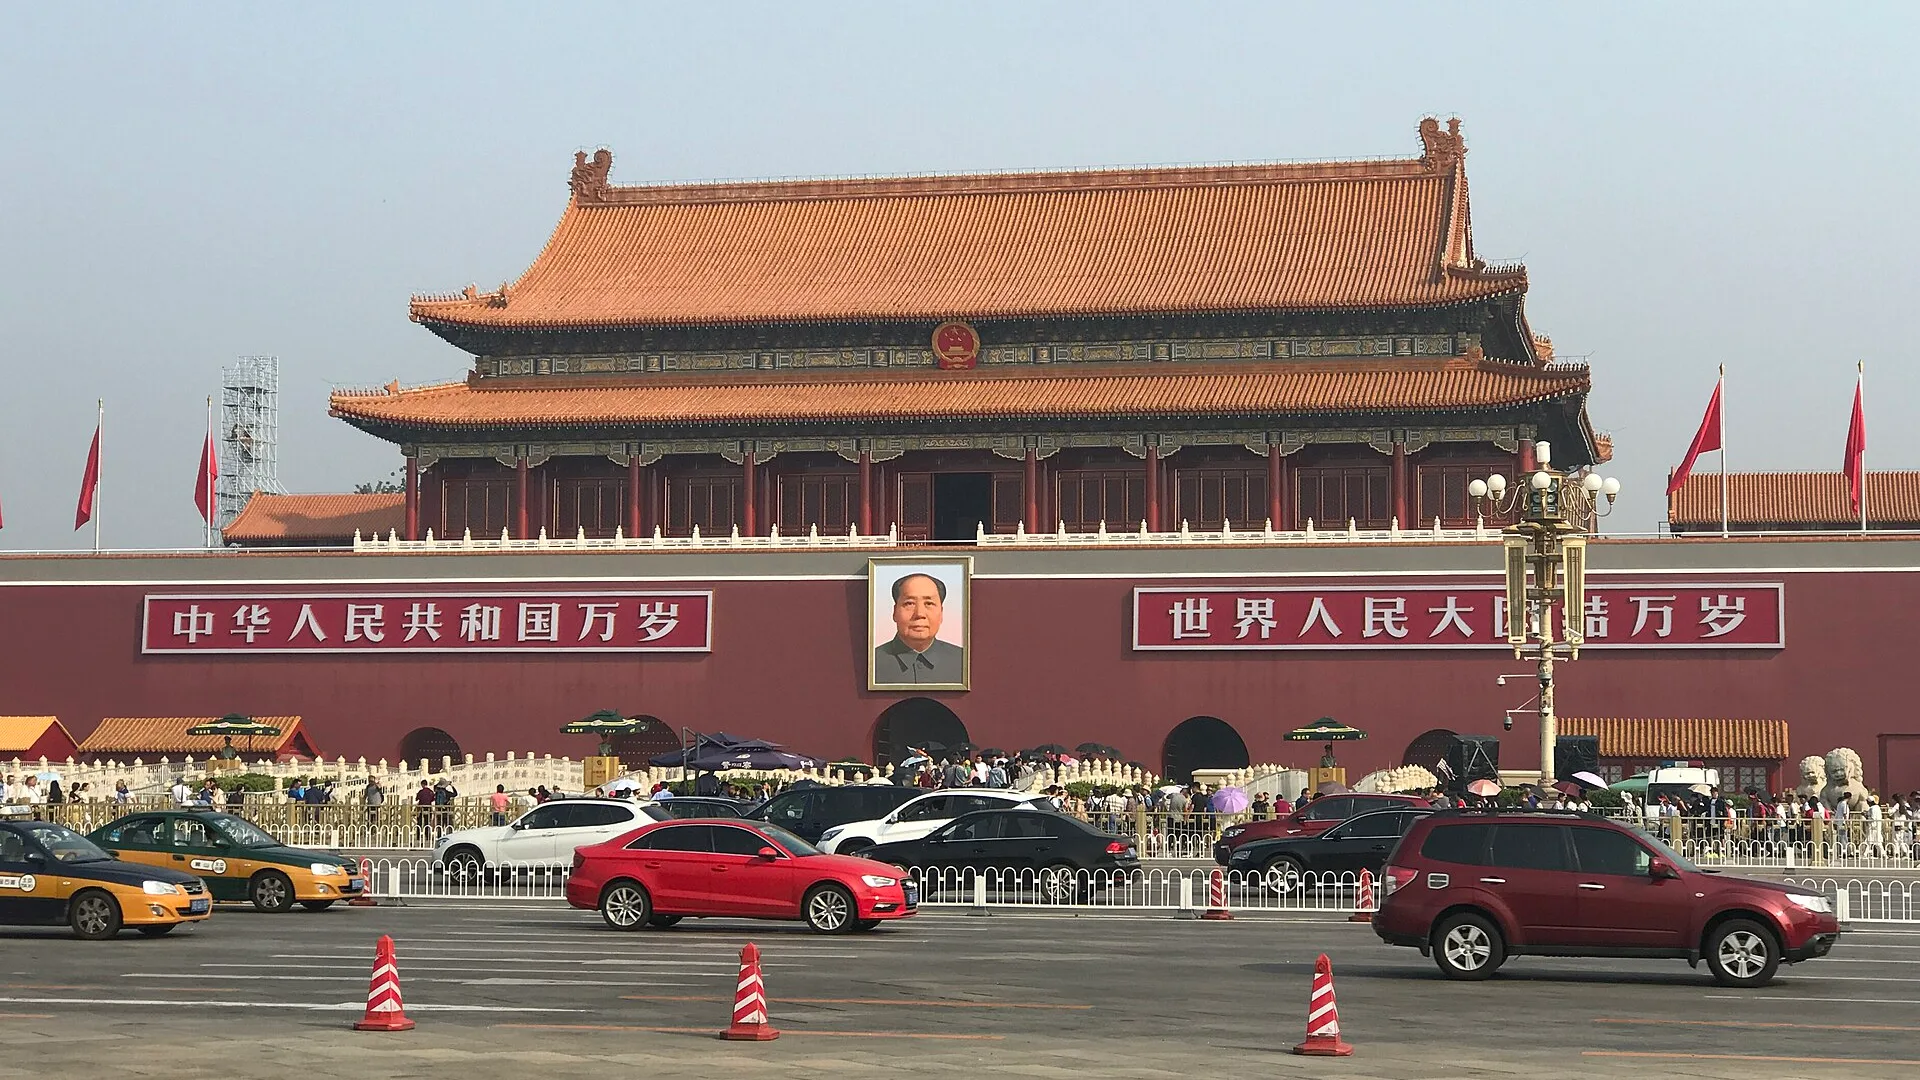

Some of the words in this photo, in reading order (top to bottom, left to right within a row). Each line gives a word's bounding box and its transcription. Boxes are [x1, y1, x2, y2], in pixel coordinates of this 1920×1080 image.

[174, 602, 679, 642] 中华人民共和国万岁
